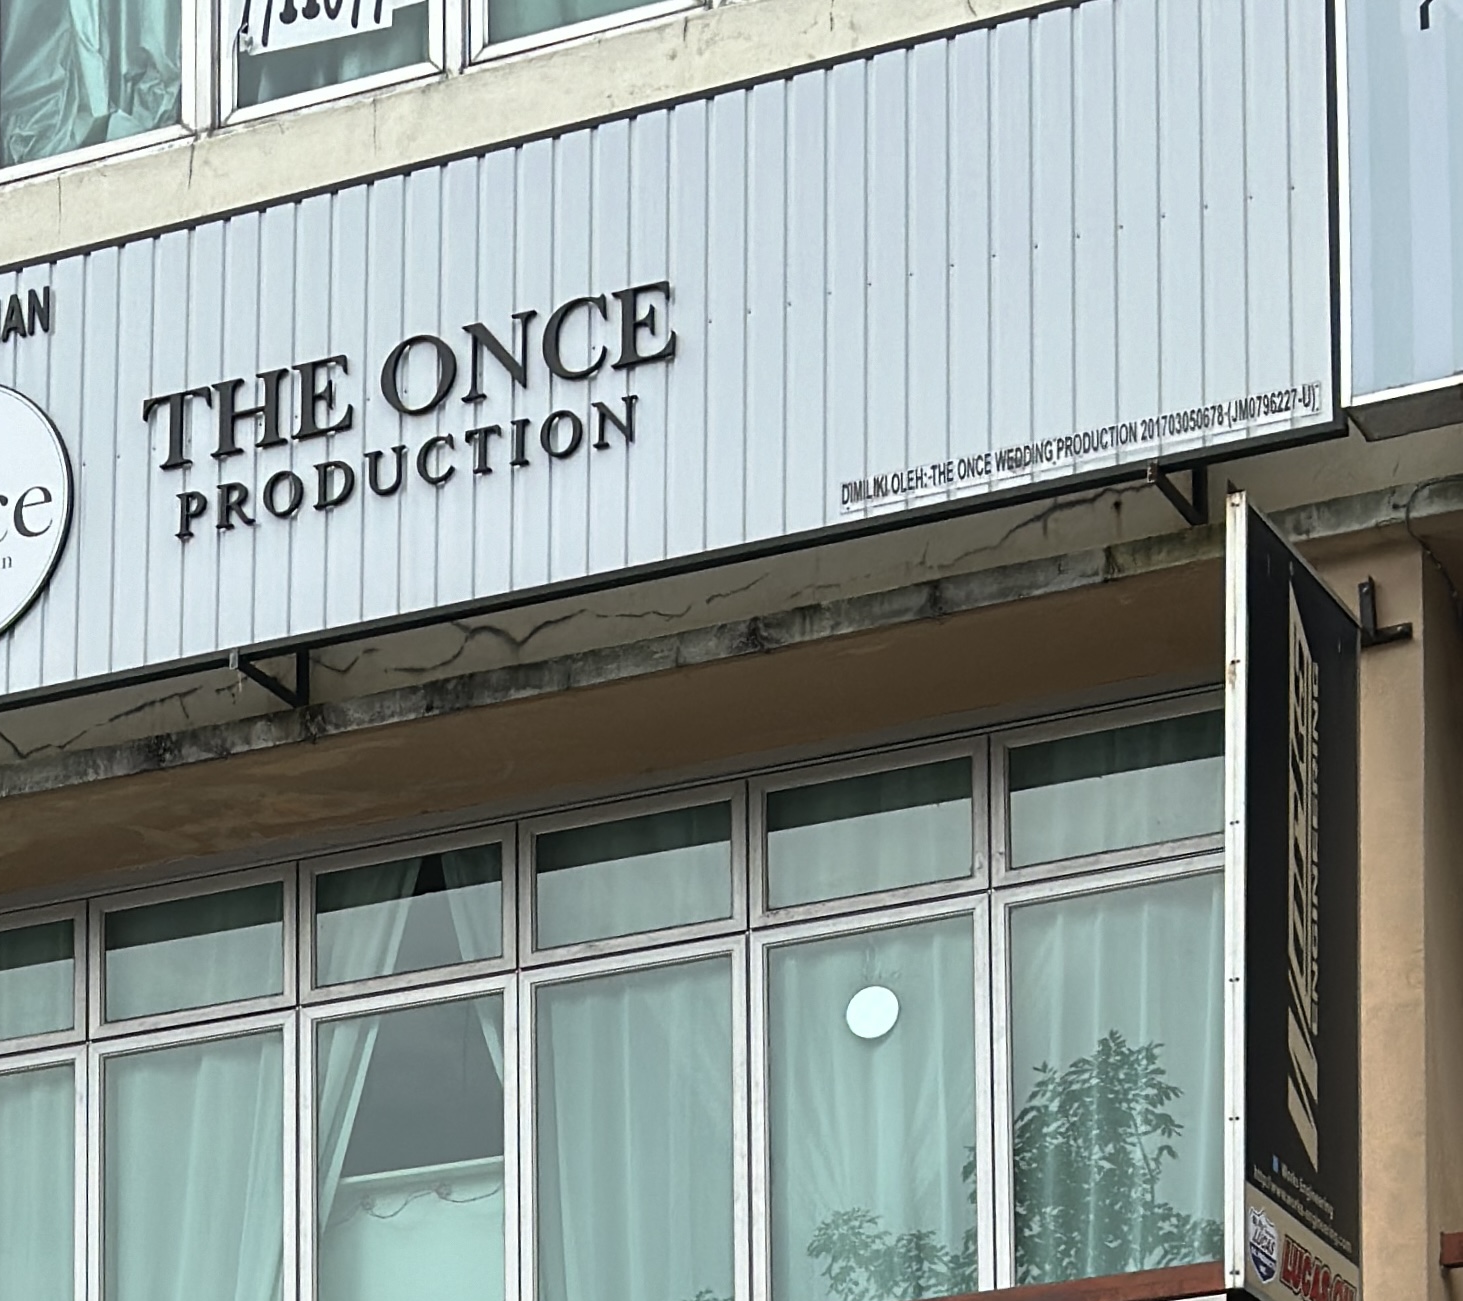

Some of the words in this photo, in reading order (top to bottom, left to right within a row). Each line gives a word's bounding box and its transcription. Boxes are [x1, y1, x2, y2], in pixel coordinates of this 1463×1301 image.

[142, 354, 354, 472] THE
[380, 280, 678, 417] ONCE
[175, 395, 638, 540] PRODUCTION
[841, 474, 887, 505] DIMILIKI
[958, 453, 991, 479] ONCE
[995, 440, 1053, 472] WEDDING
[1056, 420, 1137, 459] PRODUCTION
